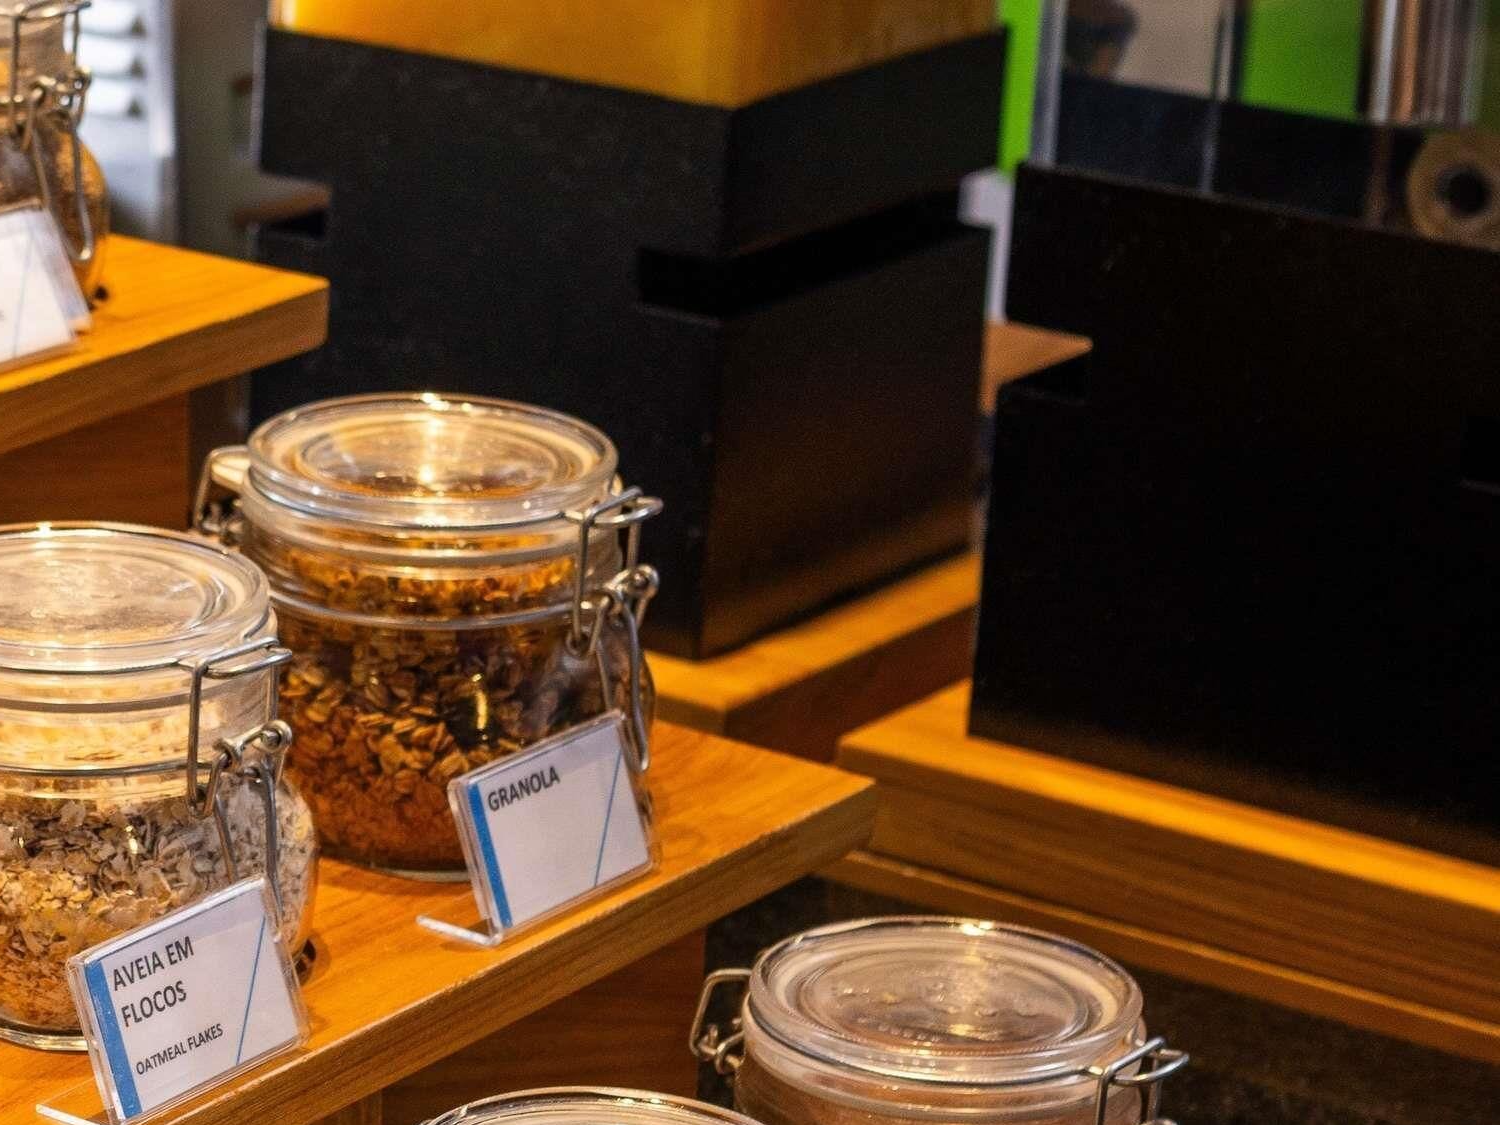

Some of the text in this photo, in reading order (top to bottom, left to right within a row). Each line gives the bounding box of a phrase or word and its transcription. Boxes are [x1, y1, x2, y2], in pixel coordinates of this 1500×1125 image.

[488, 766, 561, 812] GRANOLA
[113, 936, 195, 991] AVEIA EM
[121, 981, 188, 1028] FLOCOS
[136, 1023, 224, 1075] OATMEAL FLAKES
